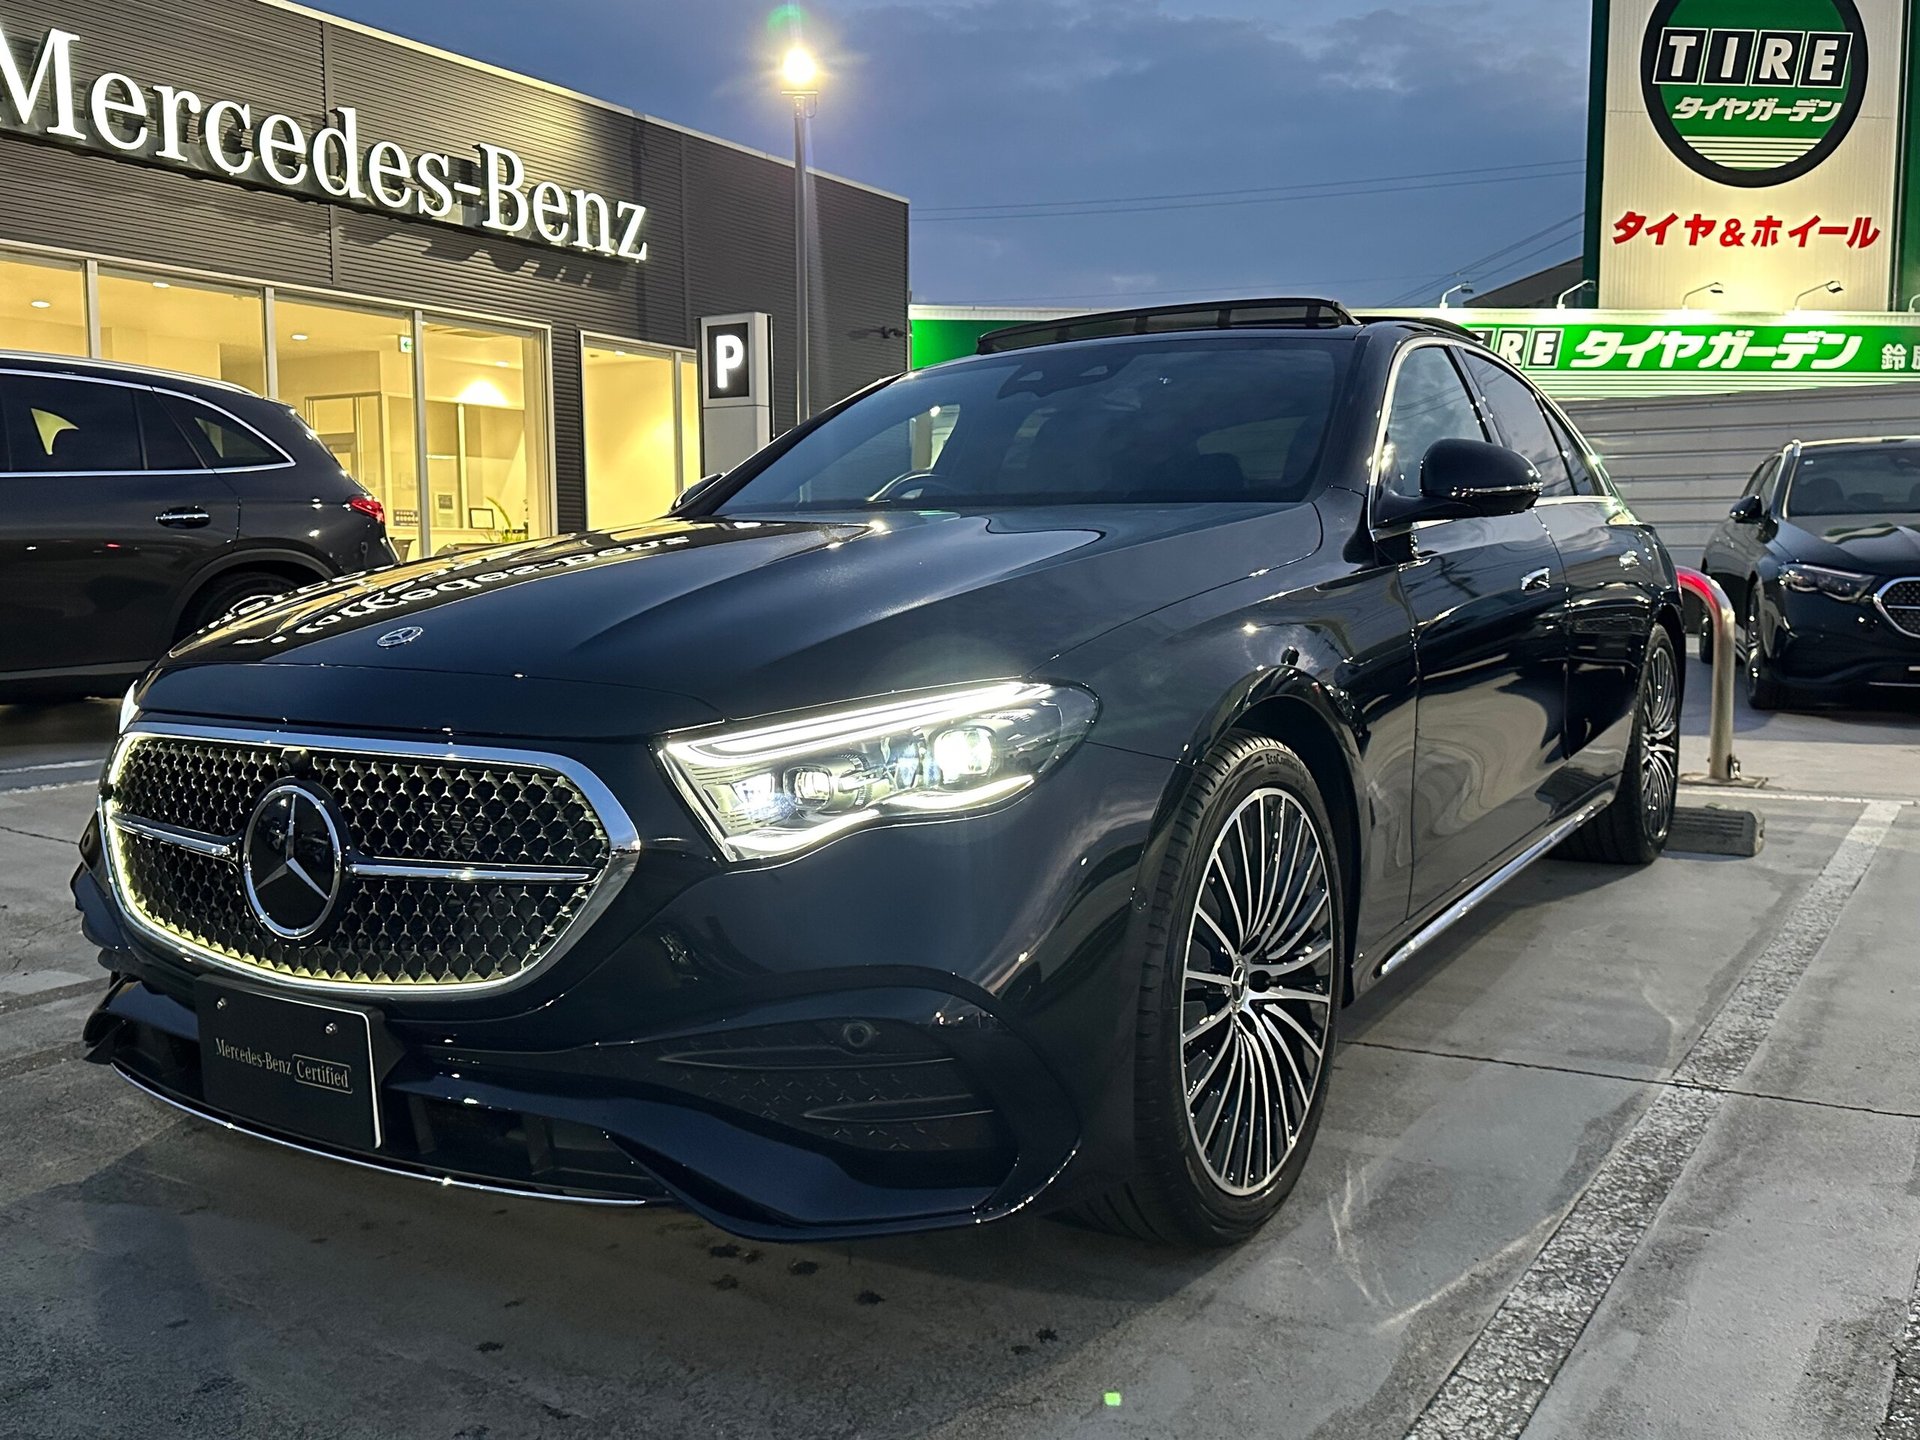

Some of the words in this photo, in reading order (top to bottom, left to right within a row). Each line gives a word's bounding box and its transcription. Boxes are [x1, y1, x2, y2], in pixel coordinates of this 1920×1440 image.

[1667, 35, 1839, 82] TIRE
[1671, 95, 1843, 123] タイヤガーデン
[0, 24, 648, 262] Mercedes-Benz
[1611, 210, 1881, 250] タイヤ&ホイール
[715, 334, 744, 389] P
[1569, 329, 1863, 370] タイヤガーデン
[215, 1037, 292, 1076] Mercedes-Benz
[296, 1059, 349, 1089] Certified
